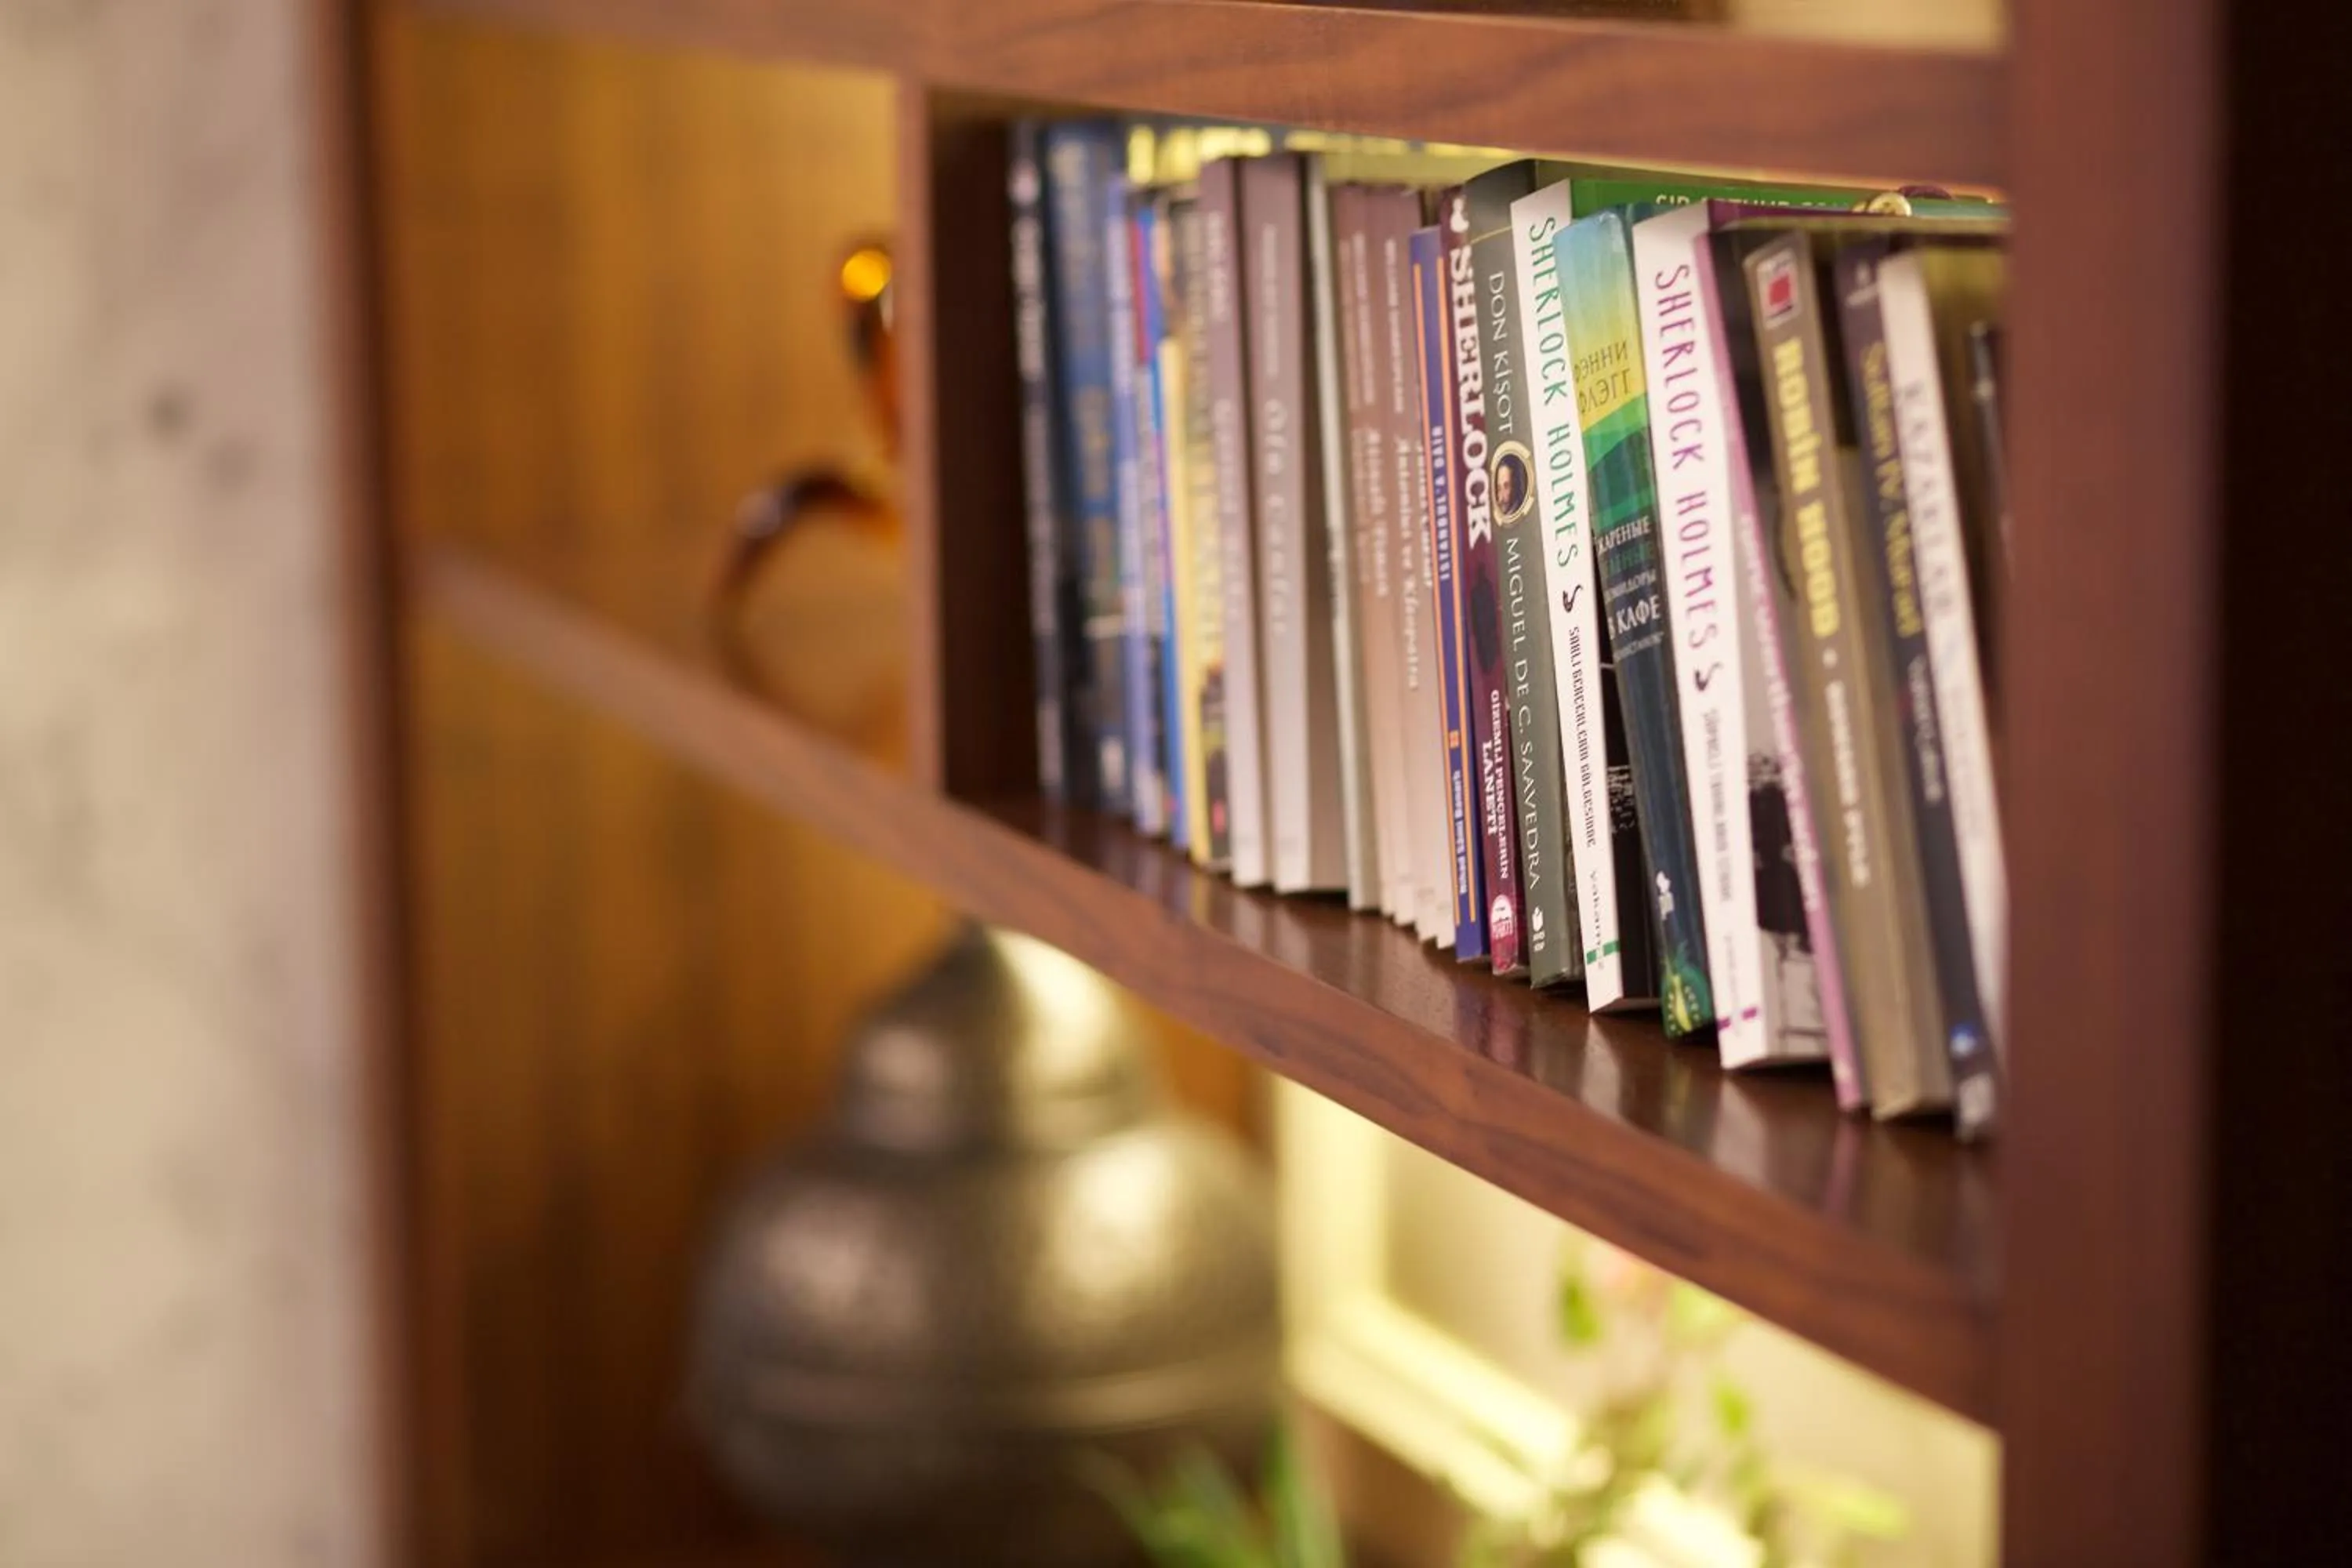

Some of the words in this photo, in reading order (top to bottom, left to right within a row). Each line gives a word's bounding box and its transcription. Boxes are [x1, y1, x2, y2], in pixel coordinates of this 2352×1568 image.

[1489, 270, 1507, 342] DON
[1530, 217, 1567, 406] SHERLOCK
[1655, 263, 1704, 470] SHERLOCK
[1450, 245, 1491, 549] SHERLOCK
[1492, 350, 1513, 434] KİŞOT
[1546, 422, 1579, 568] HOLMES
[1506, 537, 1526, 652] MIGUEL
[1615, 593, 1661, 634] КАФЕ
[1676, 491, 1718, 650] HOLMES
[1796, 499, 1840, 638] HOOD
[1514, 659, 1529, 697] DE
[1518, 705, 1532, 734] C.
[1520, 740, 1541, 890] SAAVEDRA
